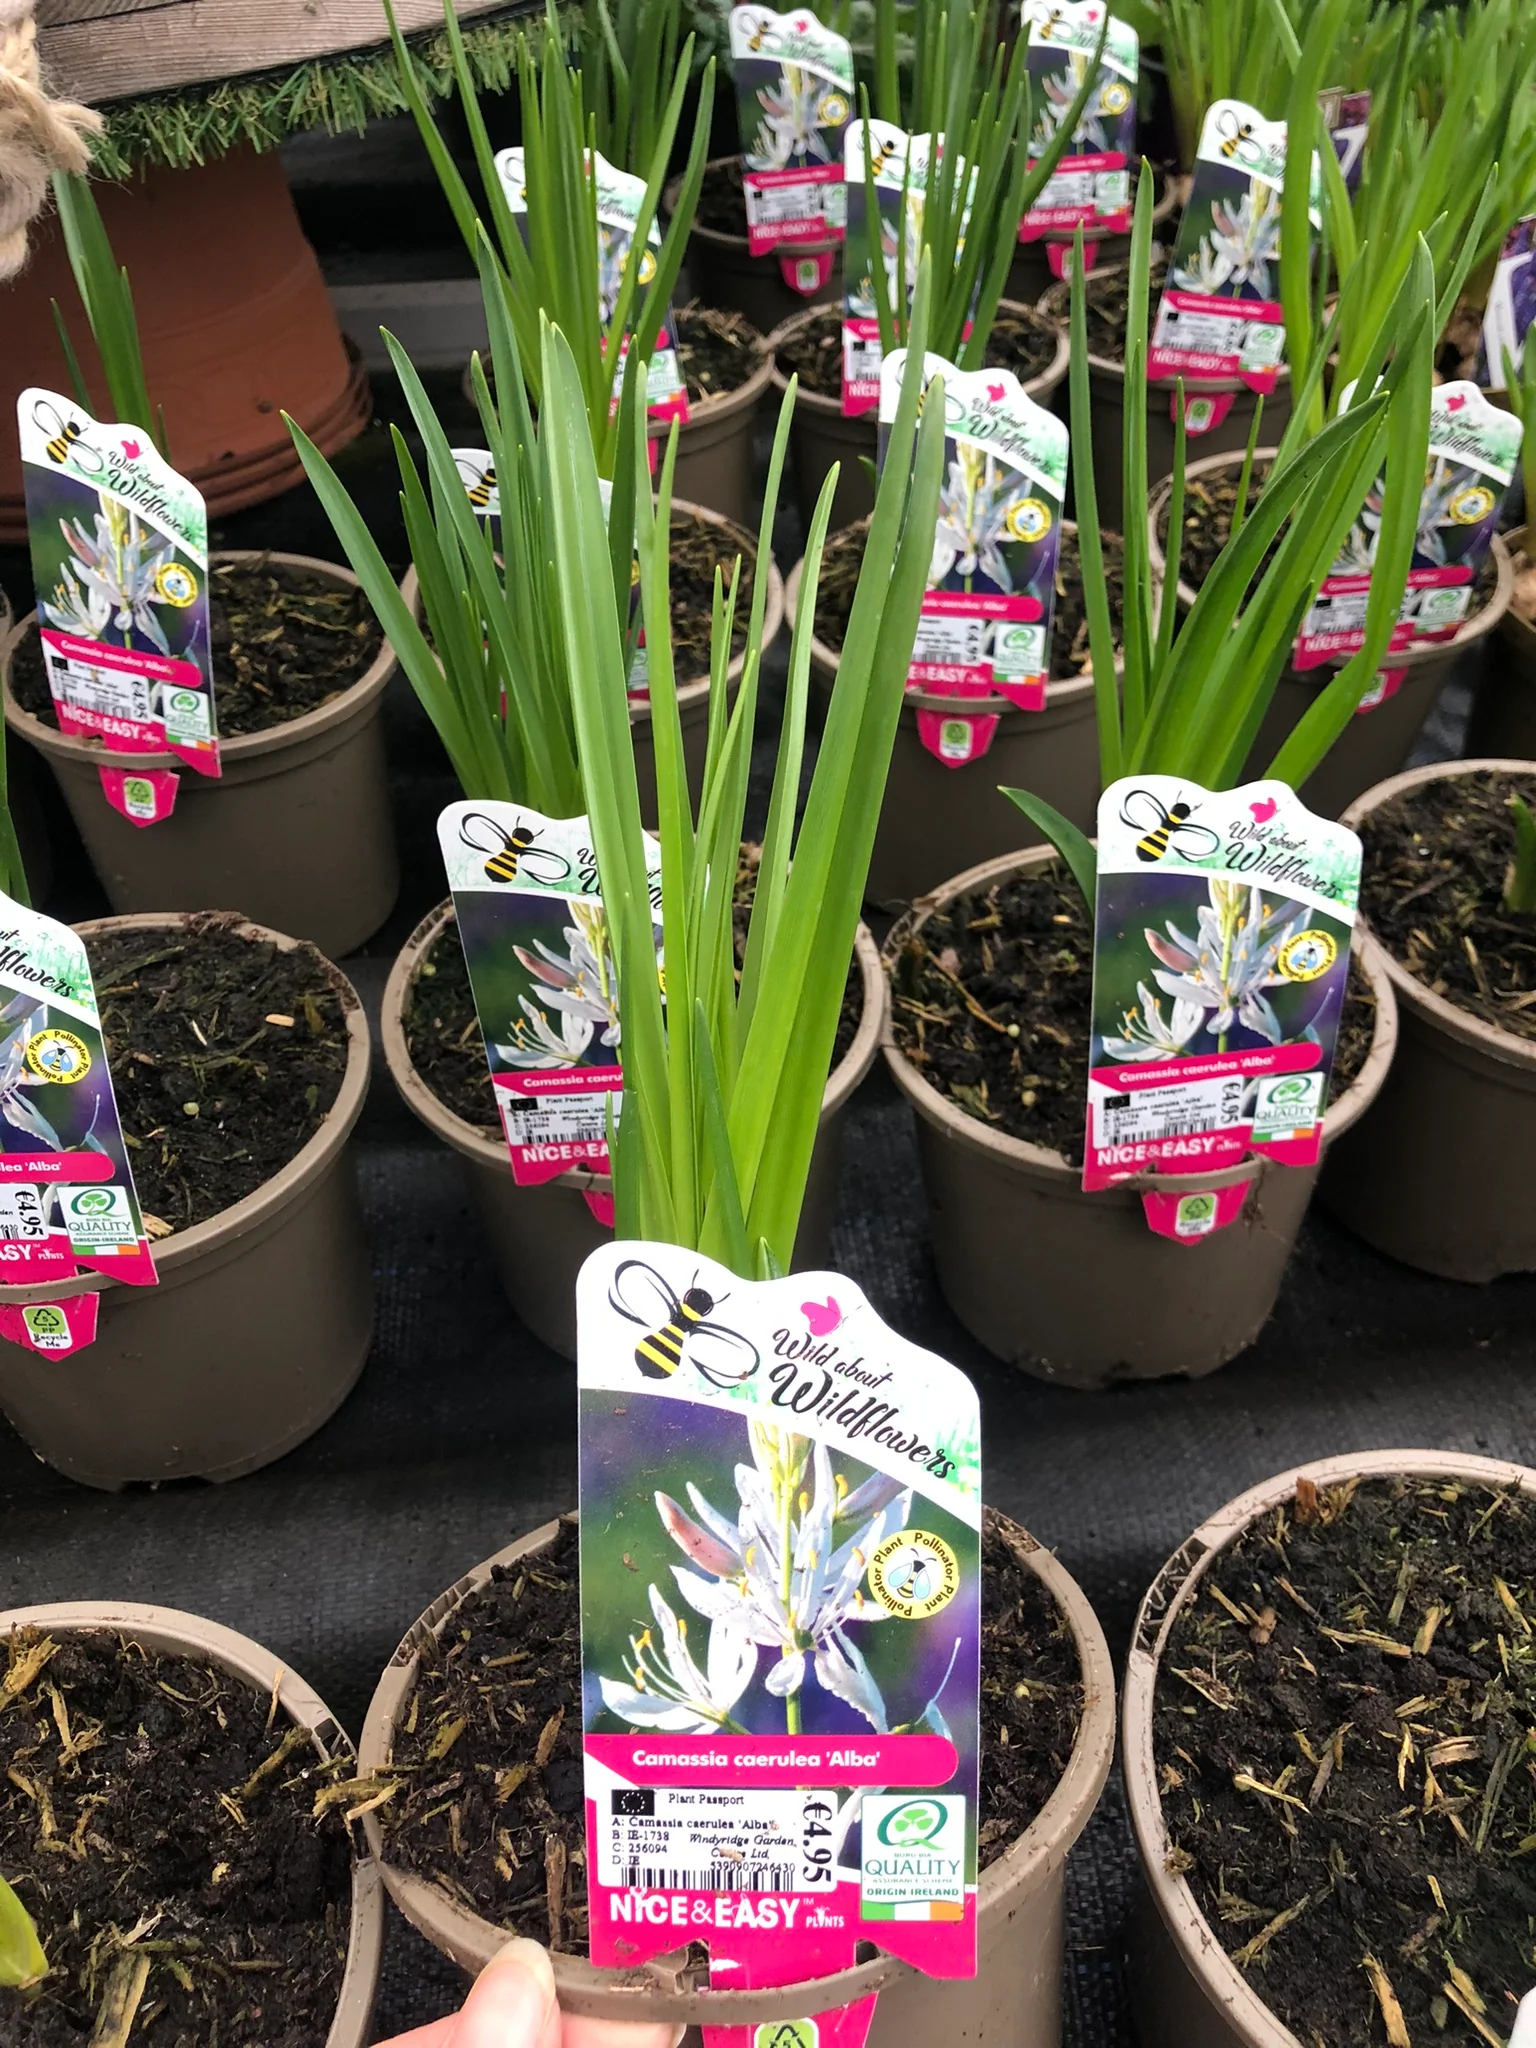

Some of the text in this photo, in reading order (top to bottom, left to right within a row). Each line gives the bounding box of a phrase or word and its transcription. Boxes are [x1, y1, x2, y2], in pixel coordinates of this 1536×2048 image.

[108, 469, 192, 541] Wildflowers
[1229, 821, 1307, 851] Wild about
[1225, 842, 1342, 899] Wildflowers
[523, 1072, 623, 1088] Camassia caerul
[1119, 1068, 1180, 1084] Camassia
[1183, 1061, 1238, 1076] caerulea
[522, 1143, 609, 1163] NICE&EA
[1097, 1136, 1215, 1167] NICE&EASY
[25, 1161, 62, 1172] 'Alba'
[14, 1190, 44, 1236] €4.95
[68, 1221, 132, 1232] QUALITY
[771, 1328, 894, 1389] Wild about
[768, 1362, 958, 1480] Wildflowers
[873, 1537, 912, 1616] Pollinator Plant
[914, 1532, 955, 1611] Pollinator Plant
[632, 1750, 881, 1767] Camassia caerulea 'Alba'
[668, 1793, 744, 1807] Plant Passport
[612, 1817, 625, 1827] A:
[629, 1817, 683, 1828] Camassia
[687, 1819, 734, 1830] caerulea
[612, 1831, 670, 1841] B: IE-1738
[690, 1833, 749, 1847] Windyridge
[803, 1802, 833, 1882] €4.95
[612, 1843, 668, 1853] C: 256094
[612, 1855, 640, 1865] D: IE
[865, 1859, 960, 1876] QUALITY
[867, 1888, 959, 1896] ORIGIN IRELAND
